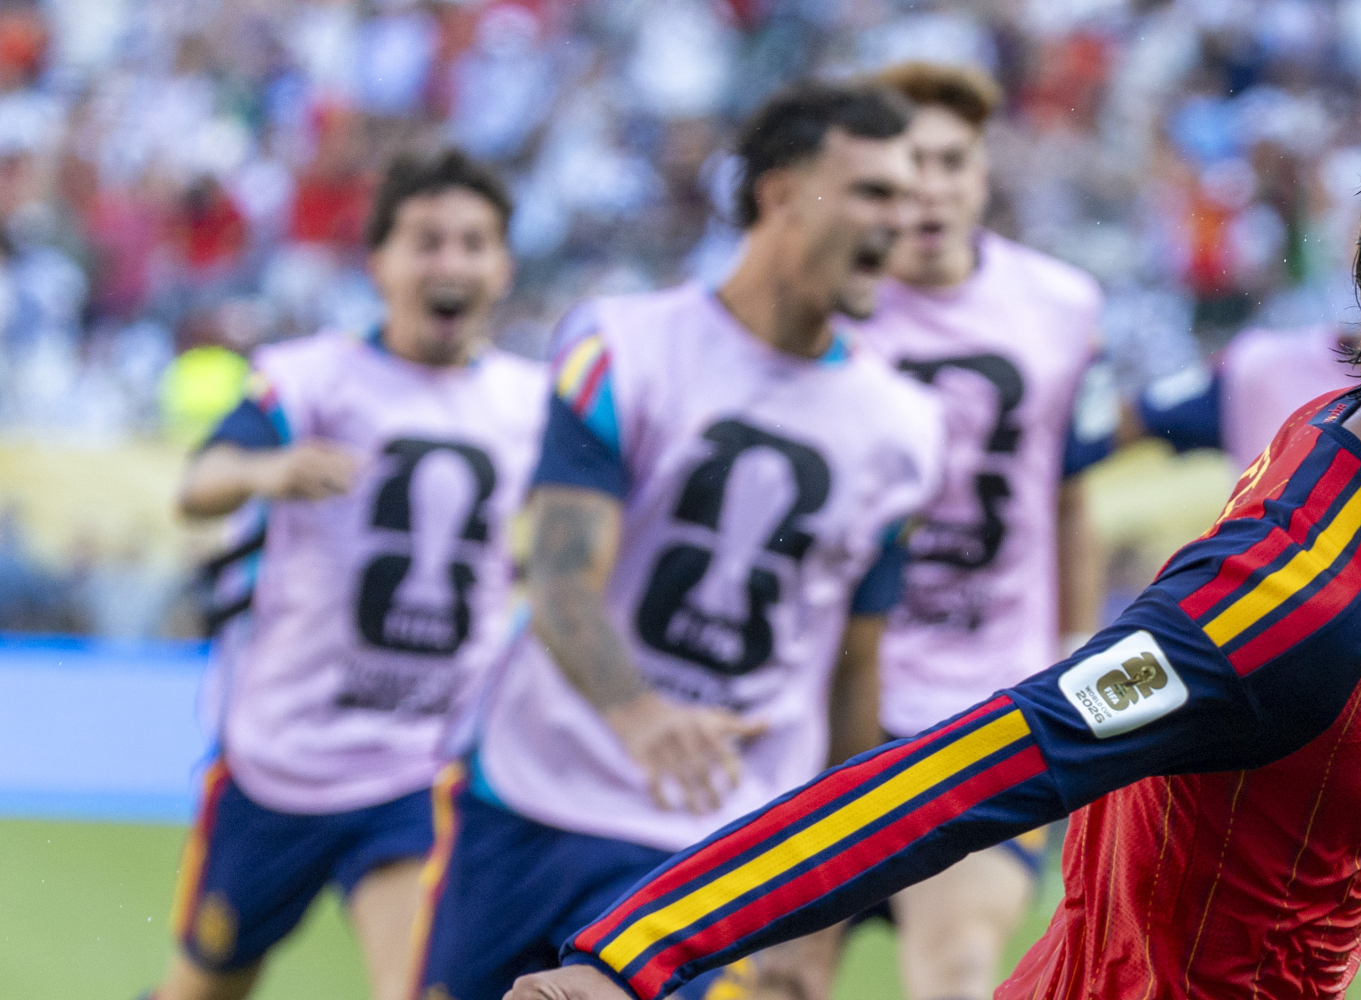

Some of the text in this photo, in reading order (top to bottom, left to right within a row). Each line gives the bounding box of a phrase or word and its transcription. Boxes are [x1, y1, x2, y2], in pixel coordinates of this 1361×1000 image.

[1075, 690, 1105, 724] 2026
[1085, 685, 1112, 718] WORLD CUP
[1103, 686, 1120, 705] FIFA
